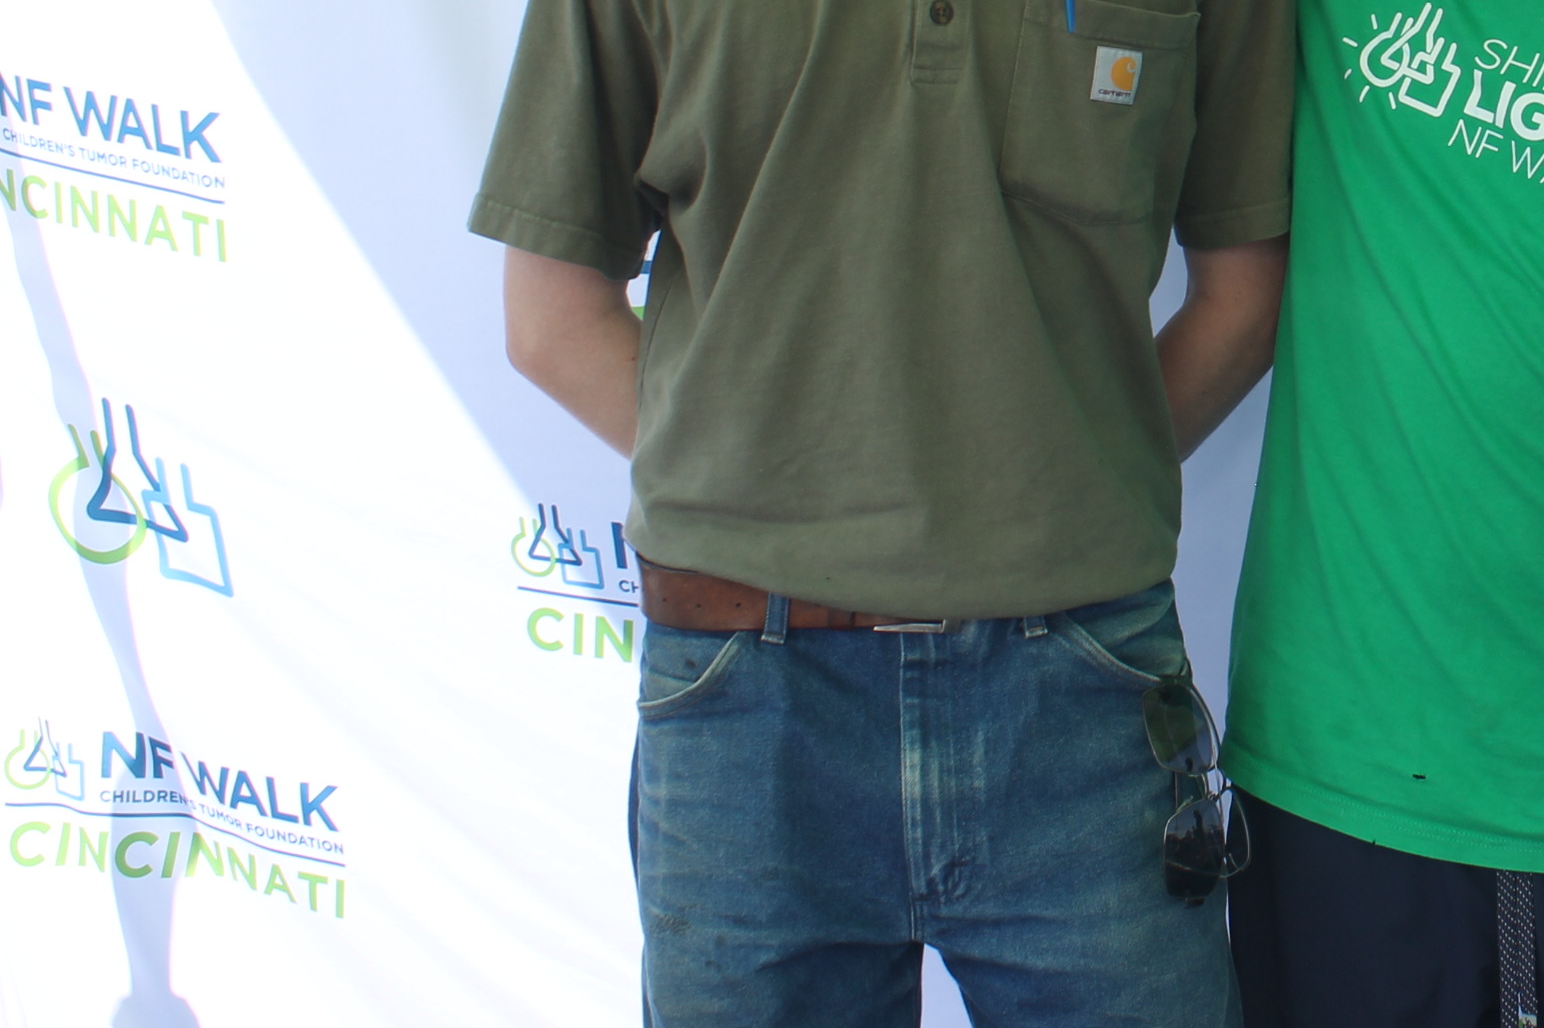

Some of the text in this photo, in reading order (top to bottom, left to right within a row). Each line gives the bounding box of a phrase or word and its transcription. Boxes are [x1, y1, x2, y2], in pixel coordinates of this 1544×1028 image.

[0, 71, 222, 163] NF WALK
[1448, 119, 1503, 158] NF
[2, 128, 225, 188] CHILDREN'S TUMOR FOUNDATION
[527, 607, 634, 663] CIN
[101, 731, 339, 832] NF WALK
[199, 803, 242, 828] TUMOR
[246, 821, 345, 855] FOUNDATION
[9, 820, 345, 919] CINCINNATI
